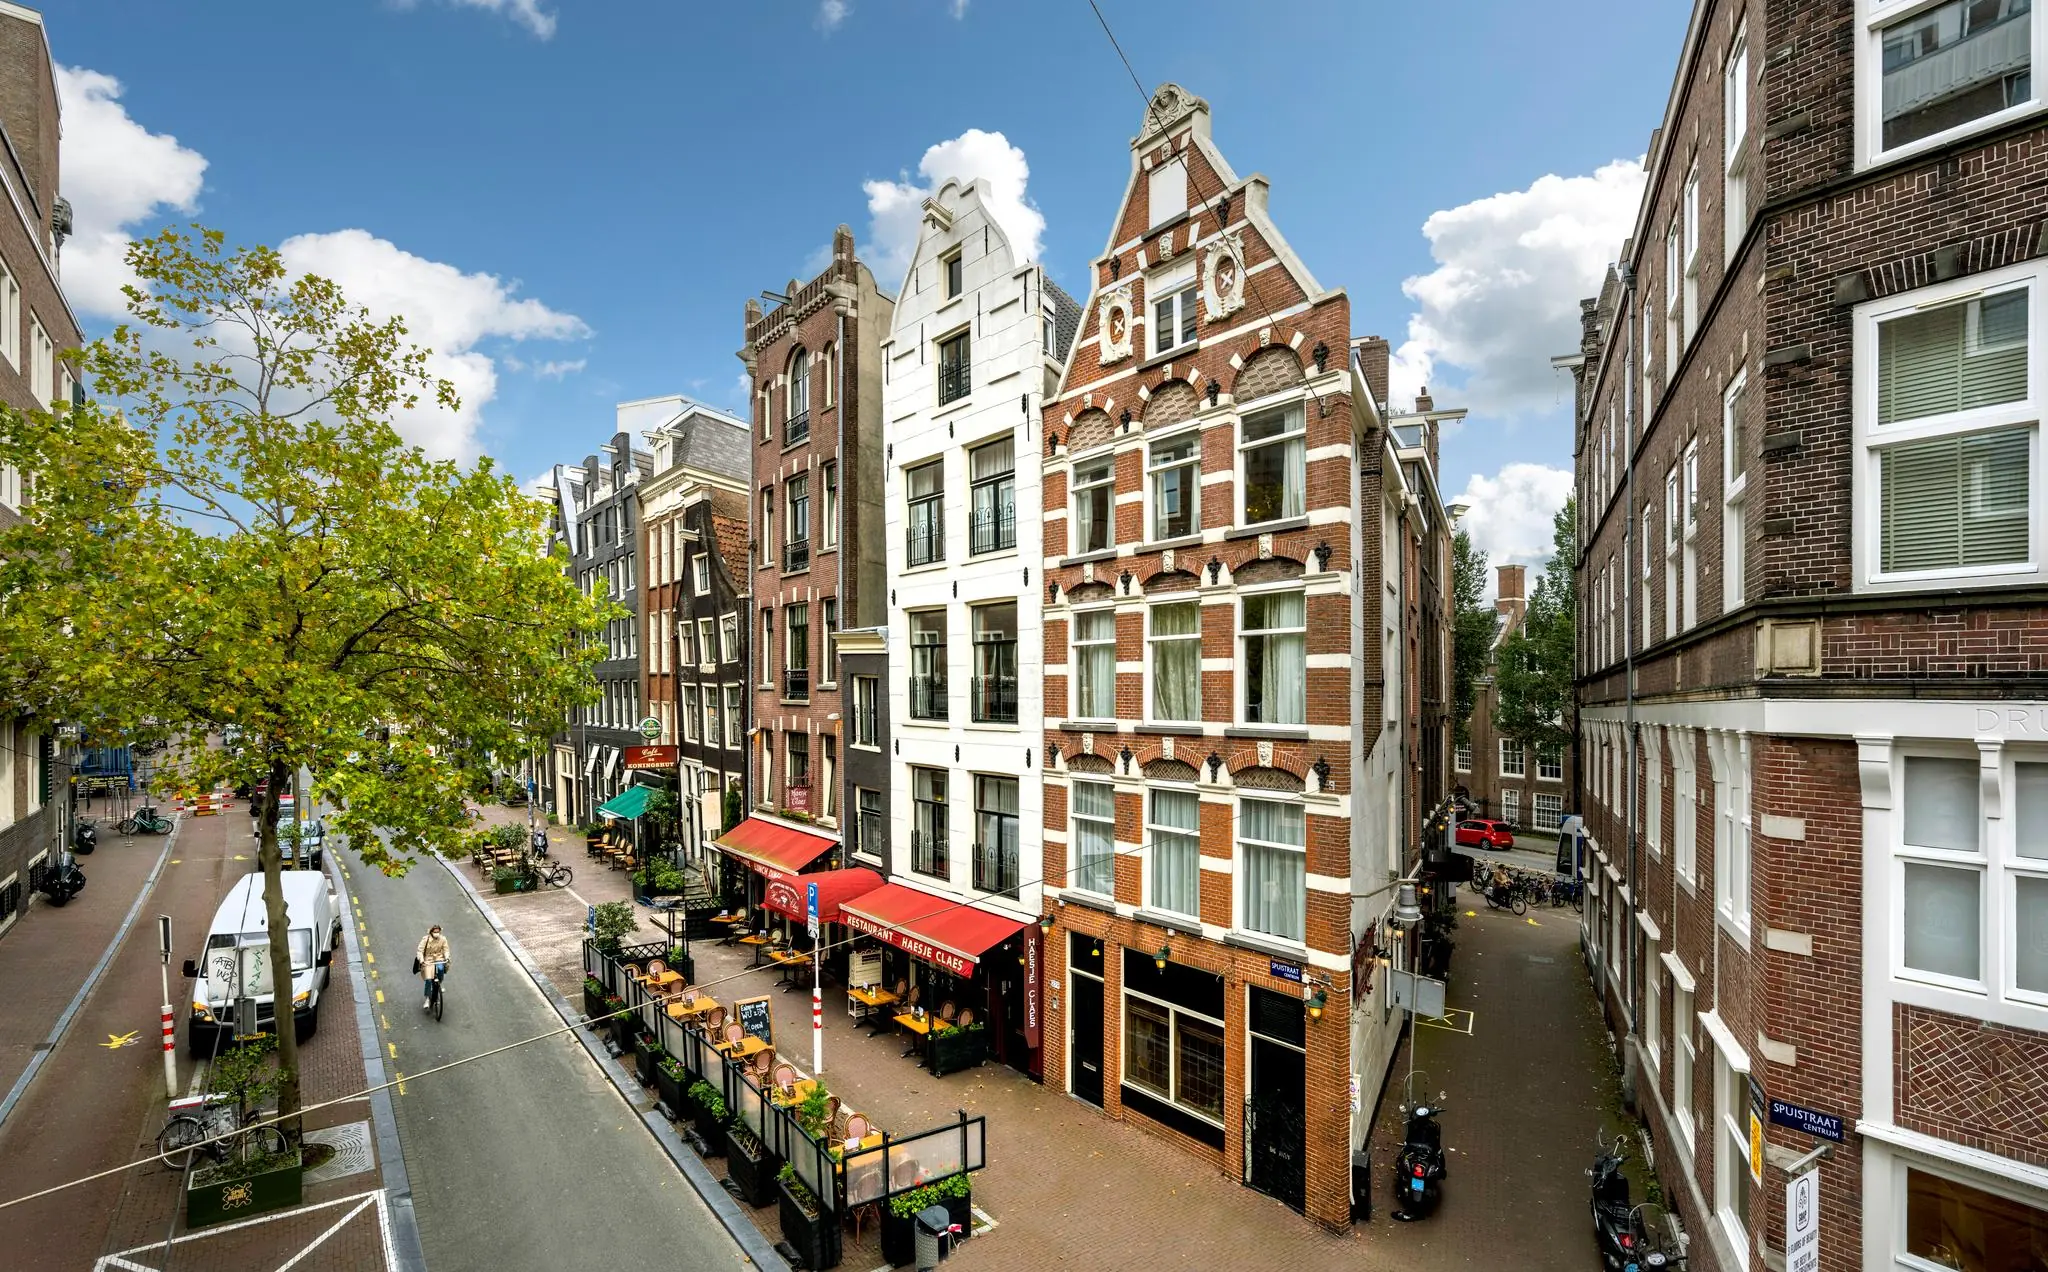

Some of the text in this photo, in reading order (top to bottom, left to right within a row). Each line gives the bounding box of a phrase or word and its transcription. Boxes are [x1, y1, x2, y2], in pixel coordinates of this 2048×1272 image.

[809, 886, 815, 902] P
[847, 915, 964, 971] RESTAURANT HAESJE CLAES
[1271, 962, 1300, 975] SPUISTRAAT
[1028, 938, 1036, 1028] HAESJE CLAES
[1773, 1102, 1839, 1129] SPUISTRAAT
[1803, 1122, 1839, 1139] CENTRUM
